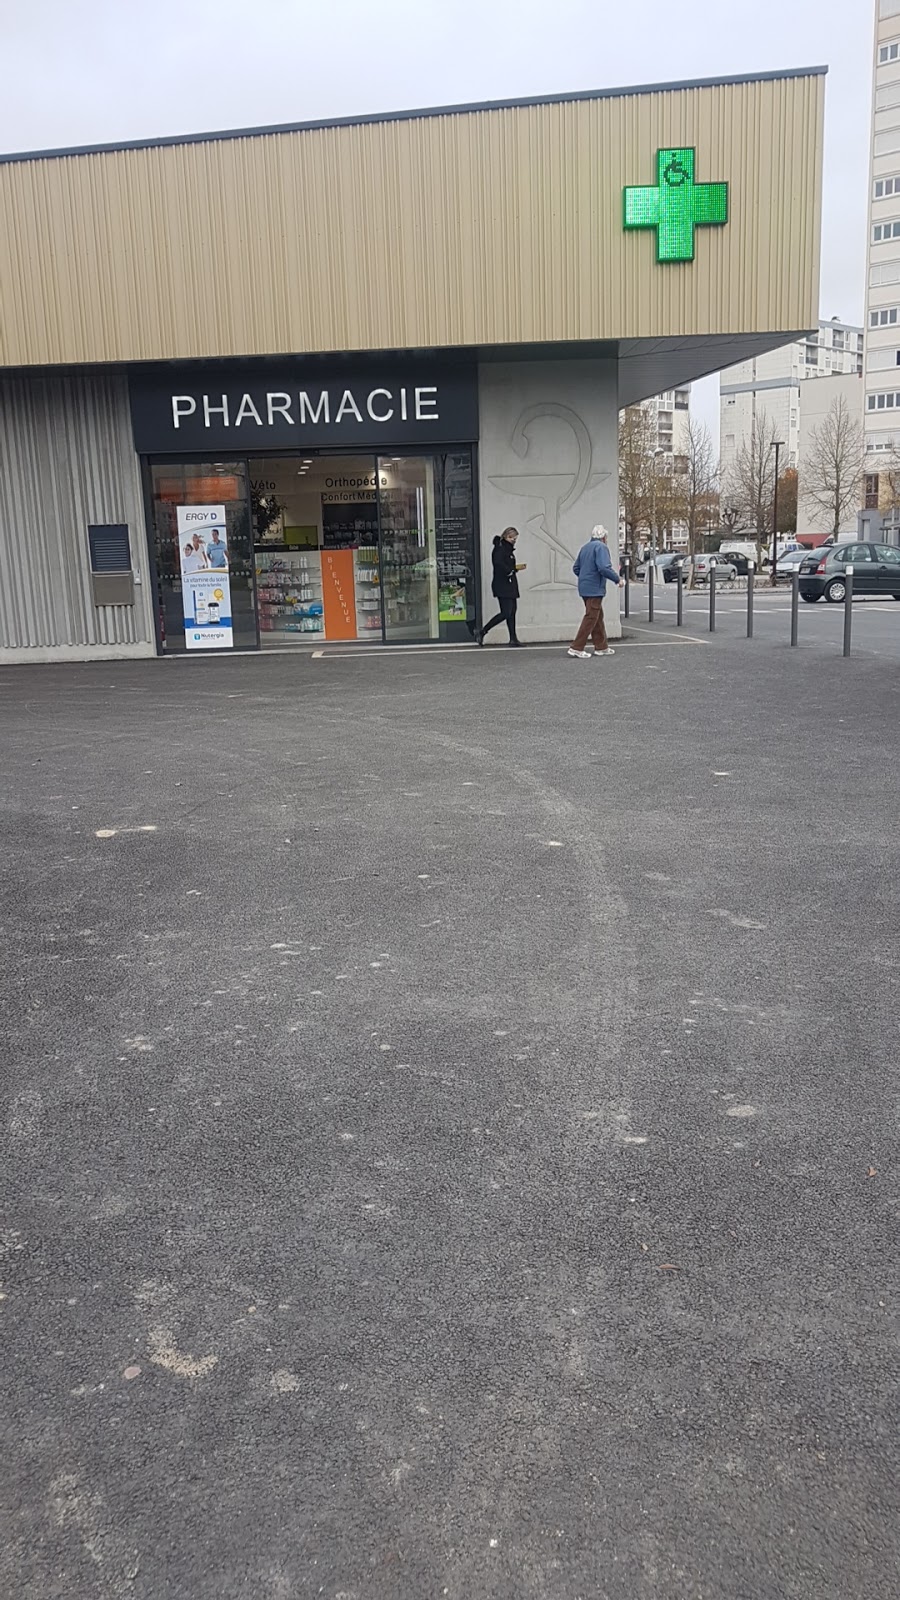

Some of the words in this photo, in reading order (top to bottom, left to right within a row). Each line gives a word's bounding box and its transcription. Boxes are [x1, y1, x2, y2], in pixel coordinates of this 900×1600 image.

[171, 387, 440, 429] PHARMACIE
[250, 479, 276, 490] Véto
[325, 476, 388, 488] Orthopéde
[321, 492, 356, 502] Confort
[185, 512, 209, 521] ERGY
[210, 512, 218, 520] D
[327, 556, 351, 623] BIENVENUE
